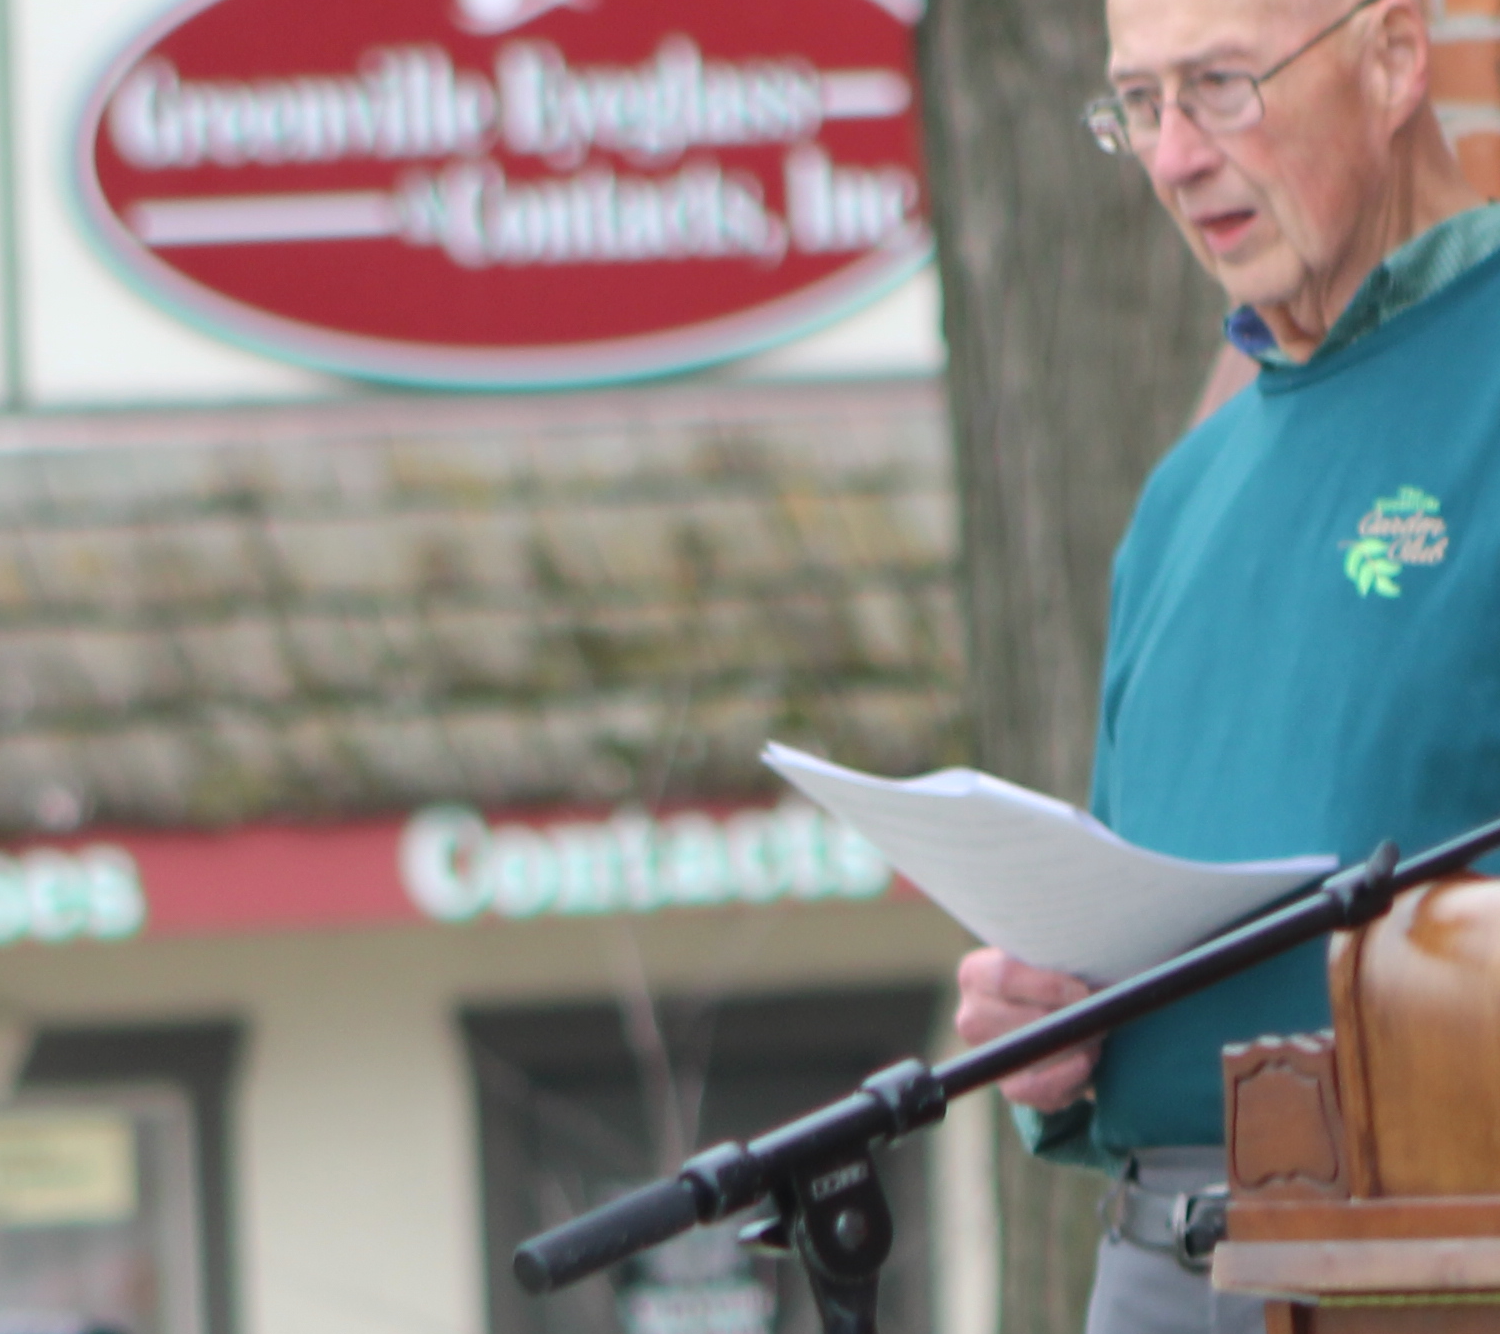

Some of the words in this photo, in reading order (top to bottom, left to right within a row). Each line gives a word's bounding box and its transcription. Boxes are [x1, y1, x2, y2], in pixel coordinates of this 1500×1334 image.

[108, 43, 494, 167] Greenville
[498, 37, 823, 170] Eyeglass
[399, 801, 893, 923] Contacts
